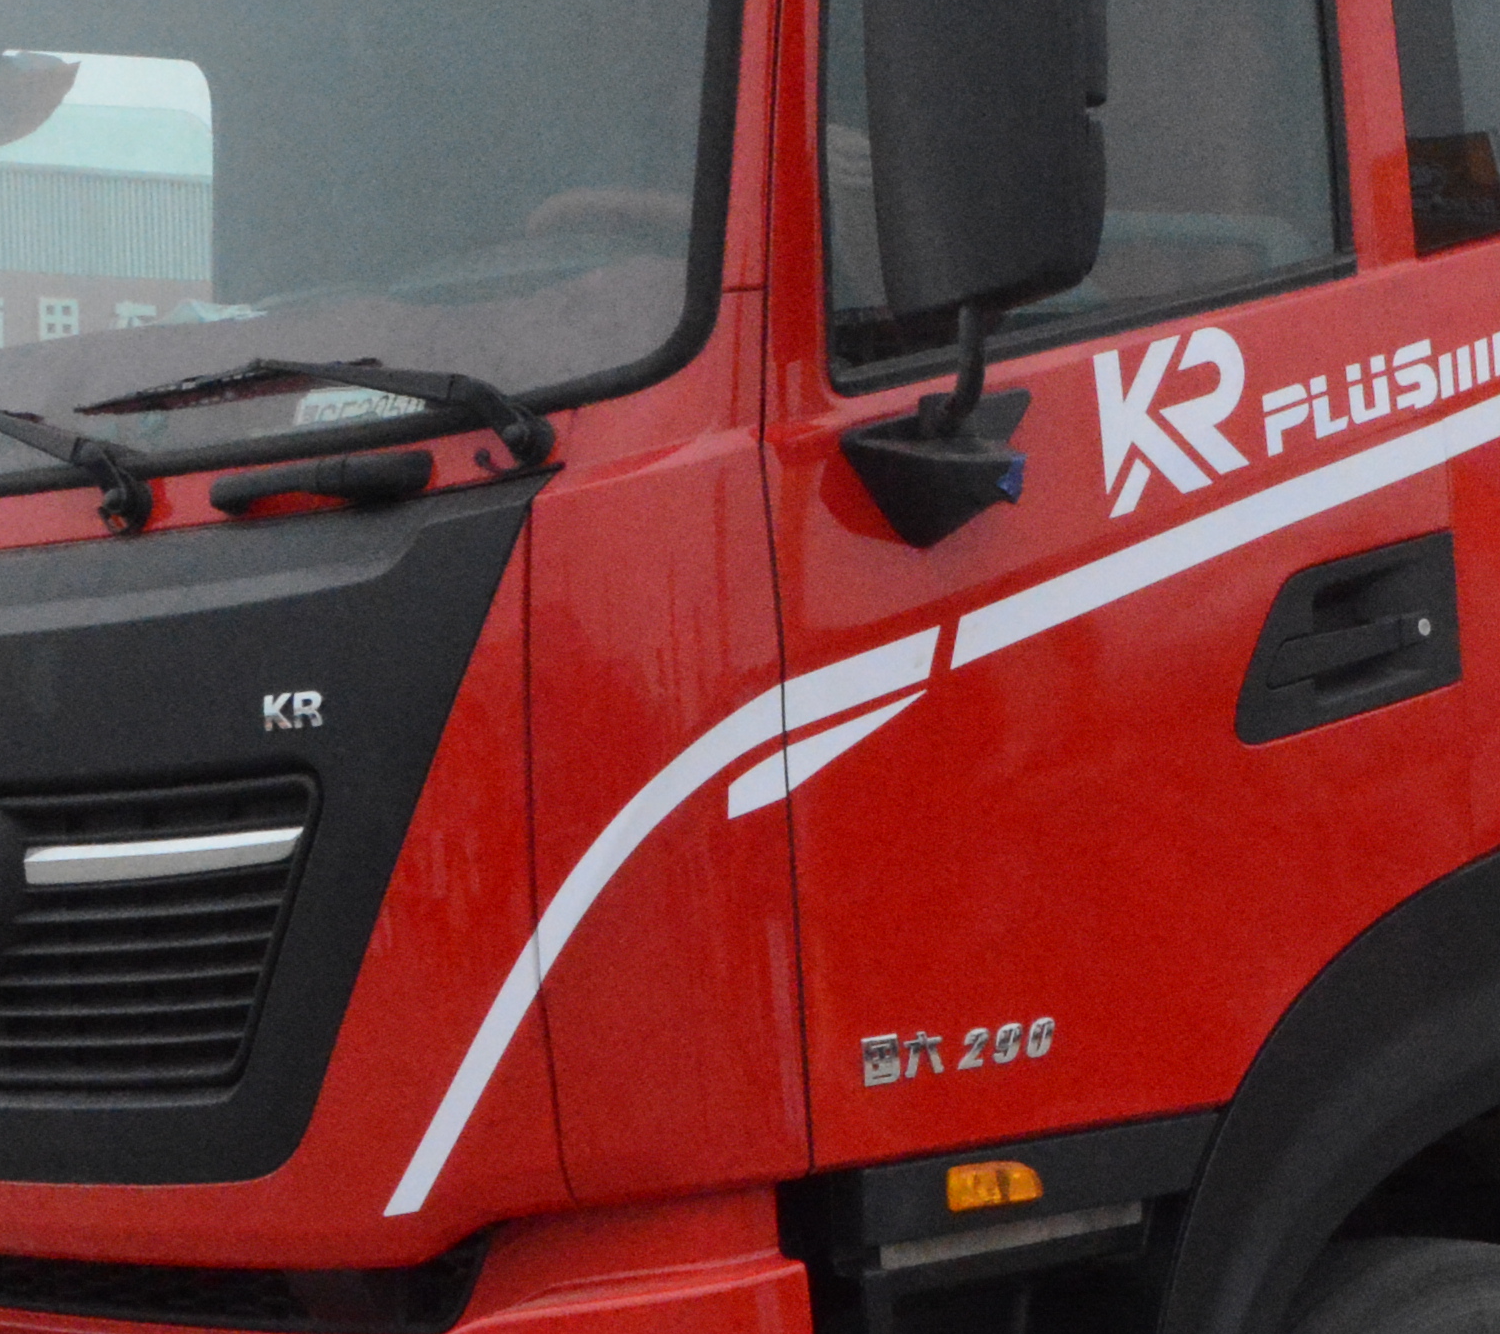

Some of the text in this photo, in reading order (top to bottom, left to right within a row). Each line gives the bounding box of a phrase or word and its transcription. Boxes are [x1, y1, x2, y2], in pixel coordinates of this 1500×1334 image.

[1093, 327, 1438, 519] KR PLUS
[263, 690, 323, 731] KR
